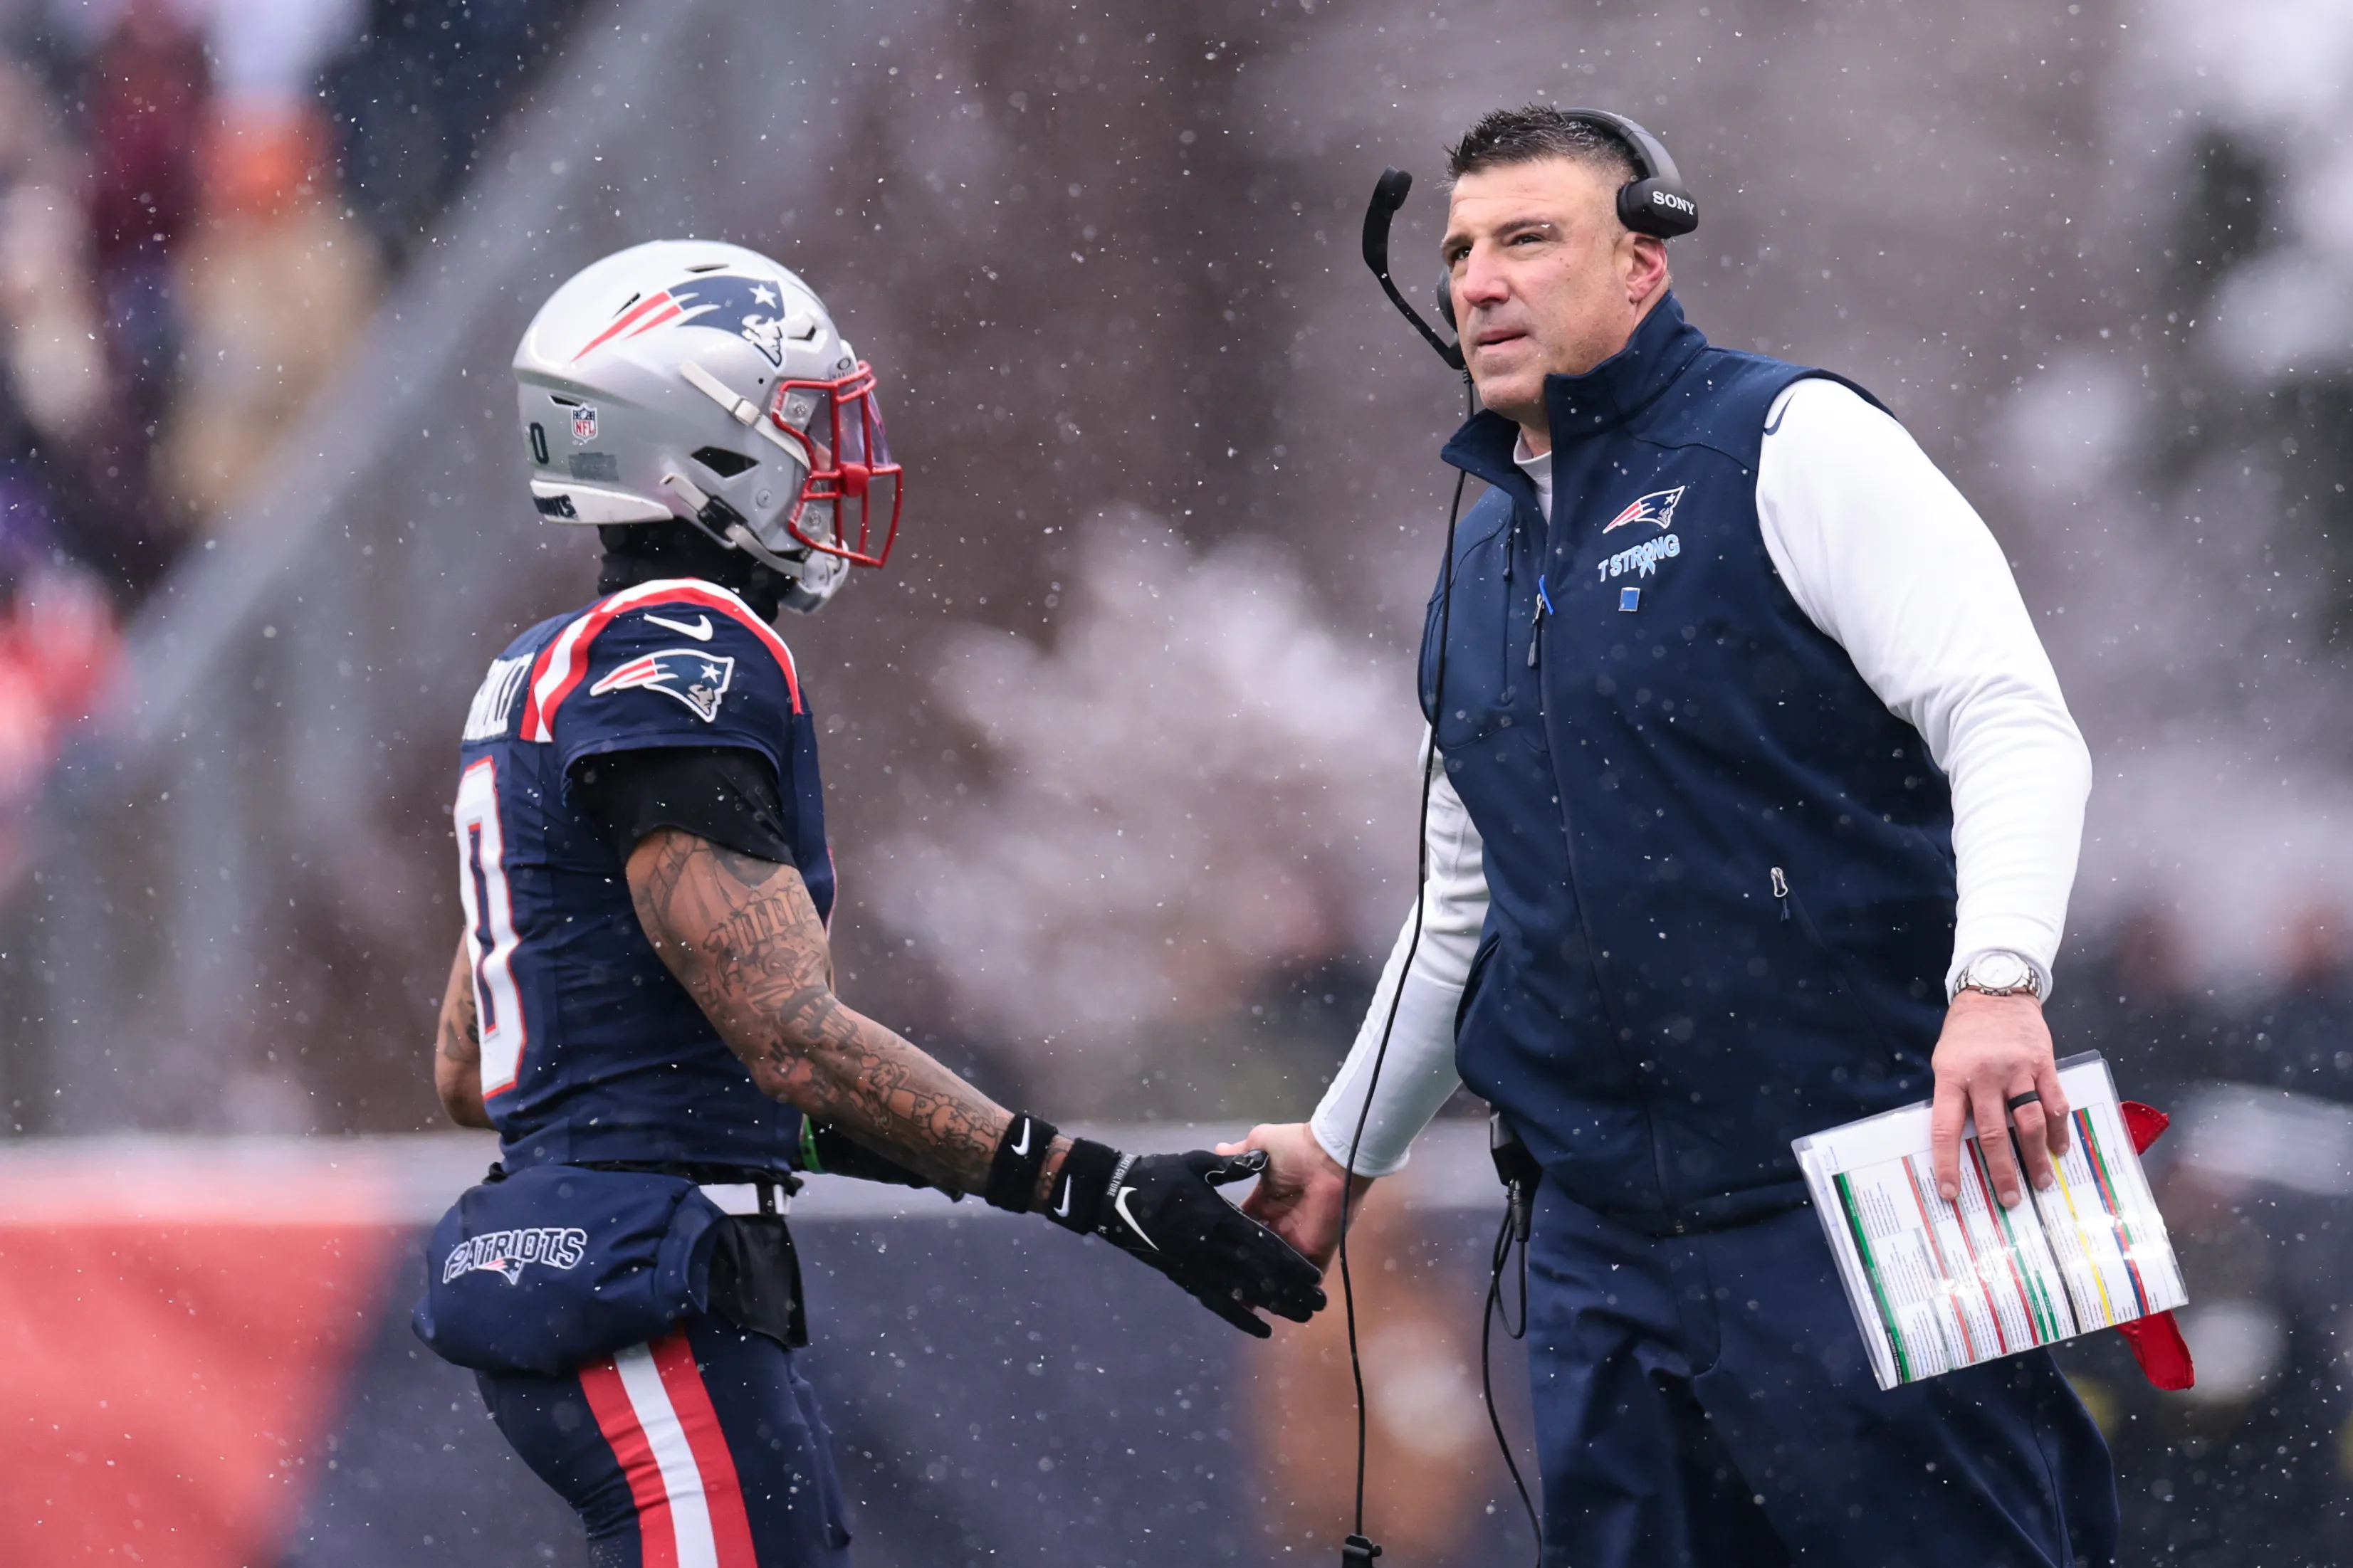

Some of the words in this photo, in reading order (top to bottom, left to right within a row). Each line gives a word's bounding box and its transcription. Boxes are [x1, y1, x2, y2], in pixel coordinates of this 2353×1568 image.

[1652, 190, 1695, 216] SONY
[530, 422, 550, 465] 0
[575, 421, 595, 436] NFL
[1609, 533, 1681, 579] STRONG
[454, 754, 528, 1101] 0
[442, 1227, 588, 1284] PATRIOTS
